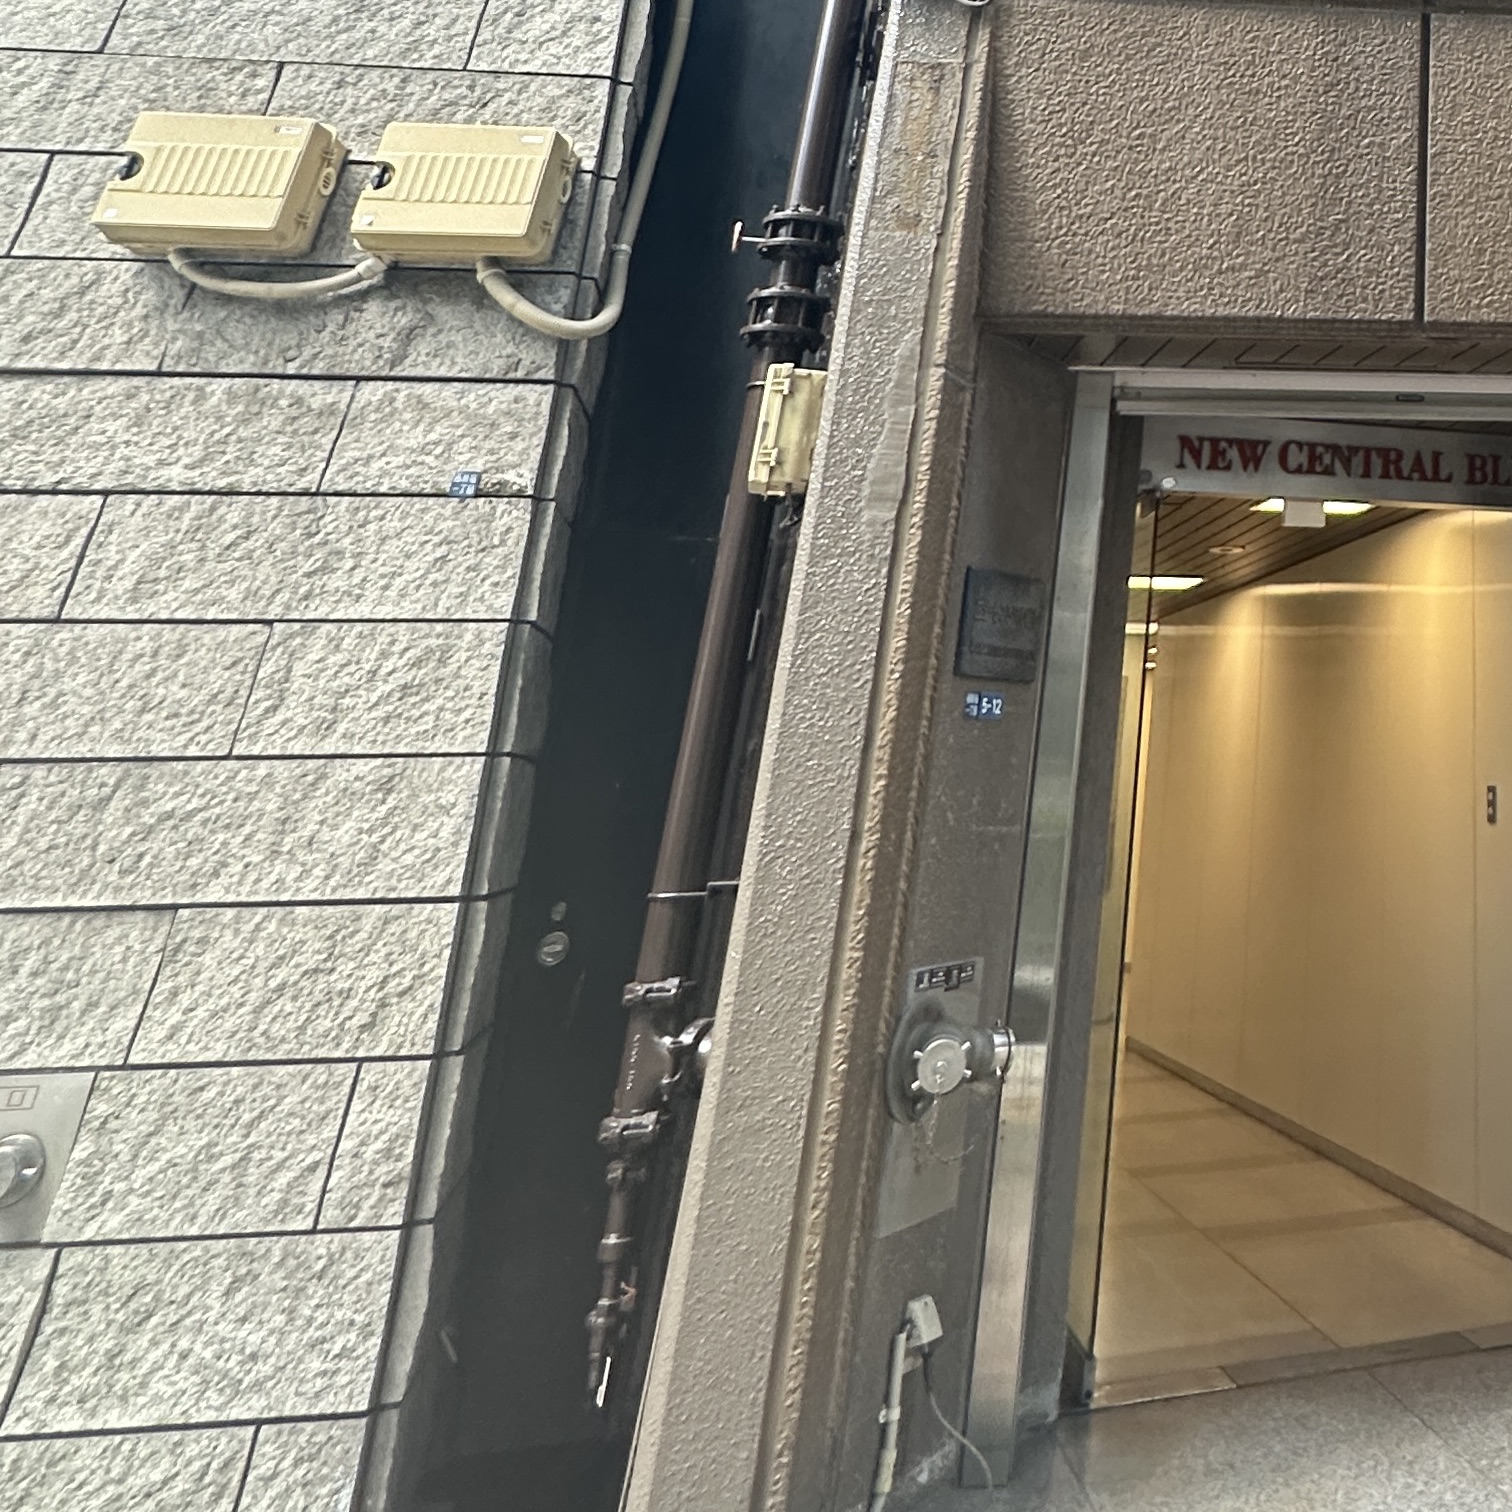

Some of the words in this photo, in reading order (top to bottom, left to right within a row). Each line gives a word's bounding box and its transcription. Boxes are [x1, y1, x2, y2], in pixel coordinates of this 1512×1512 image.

[1176, 435, 1271, 473] NEW
[1278, 440, 1452, 484] CENTRAL
[981, 697, 1003, 715] 5-12
